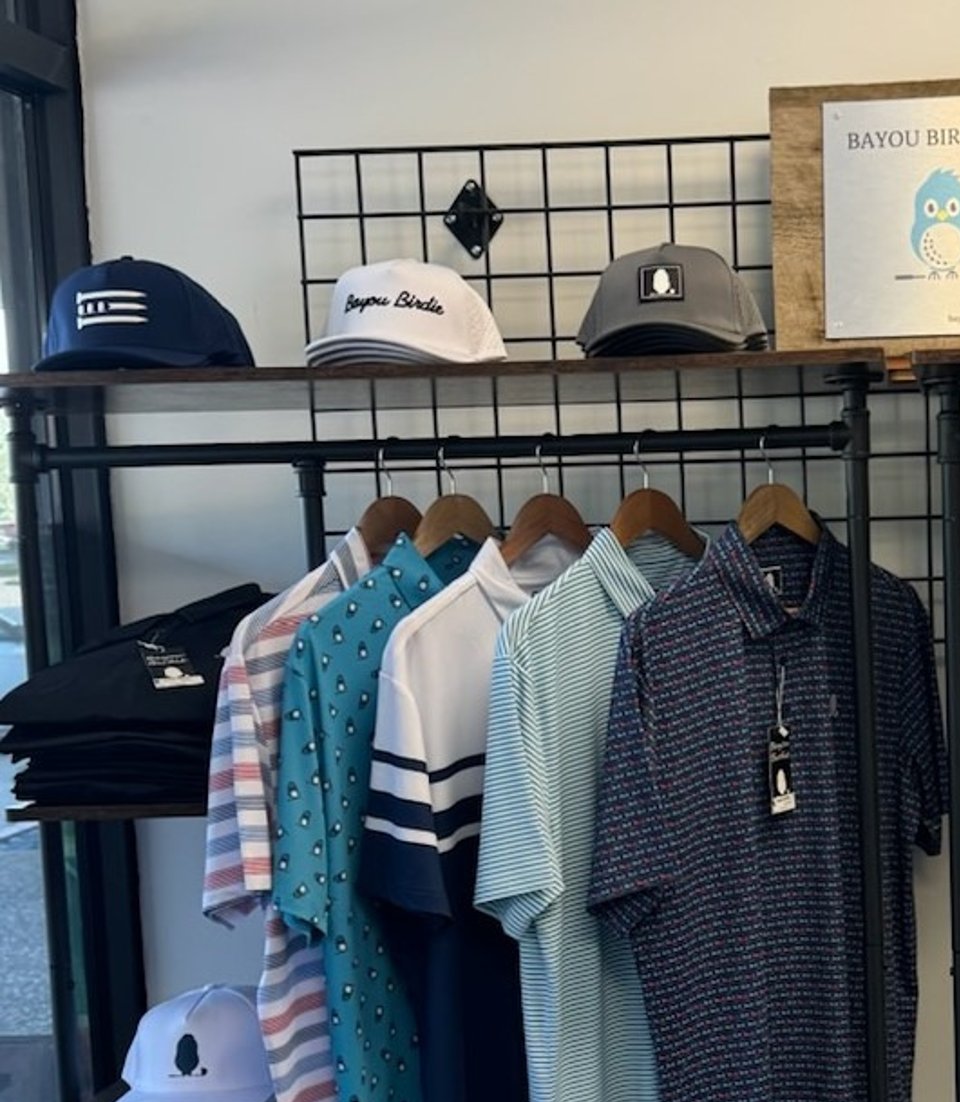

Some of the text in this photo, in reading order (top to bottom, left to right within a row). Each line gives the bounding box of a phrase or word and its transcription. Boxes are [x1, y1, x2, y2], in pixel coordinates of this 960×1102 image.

[848, 129, 920, 150] BAYOU
[344, 290, 444, 315] Bayou Birdie
